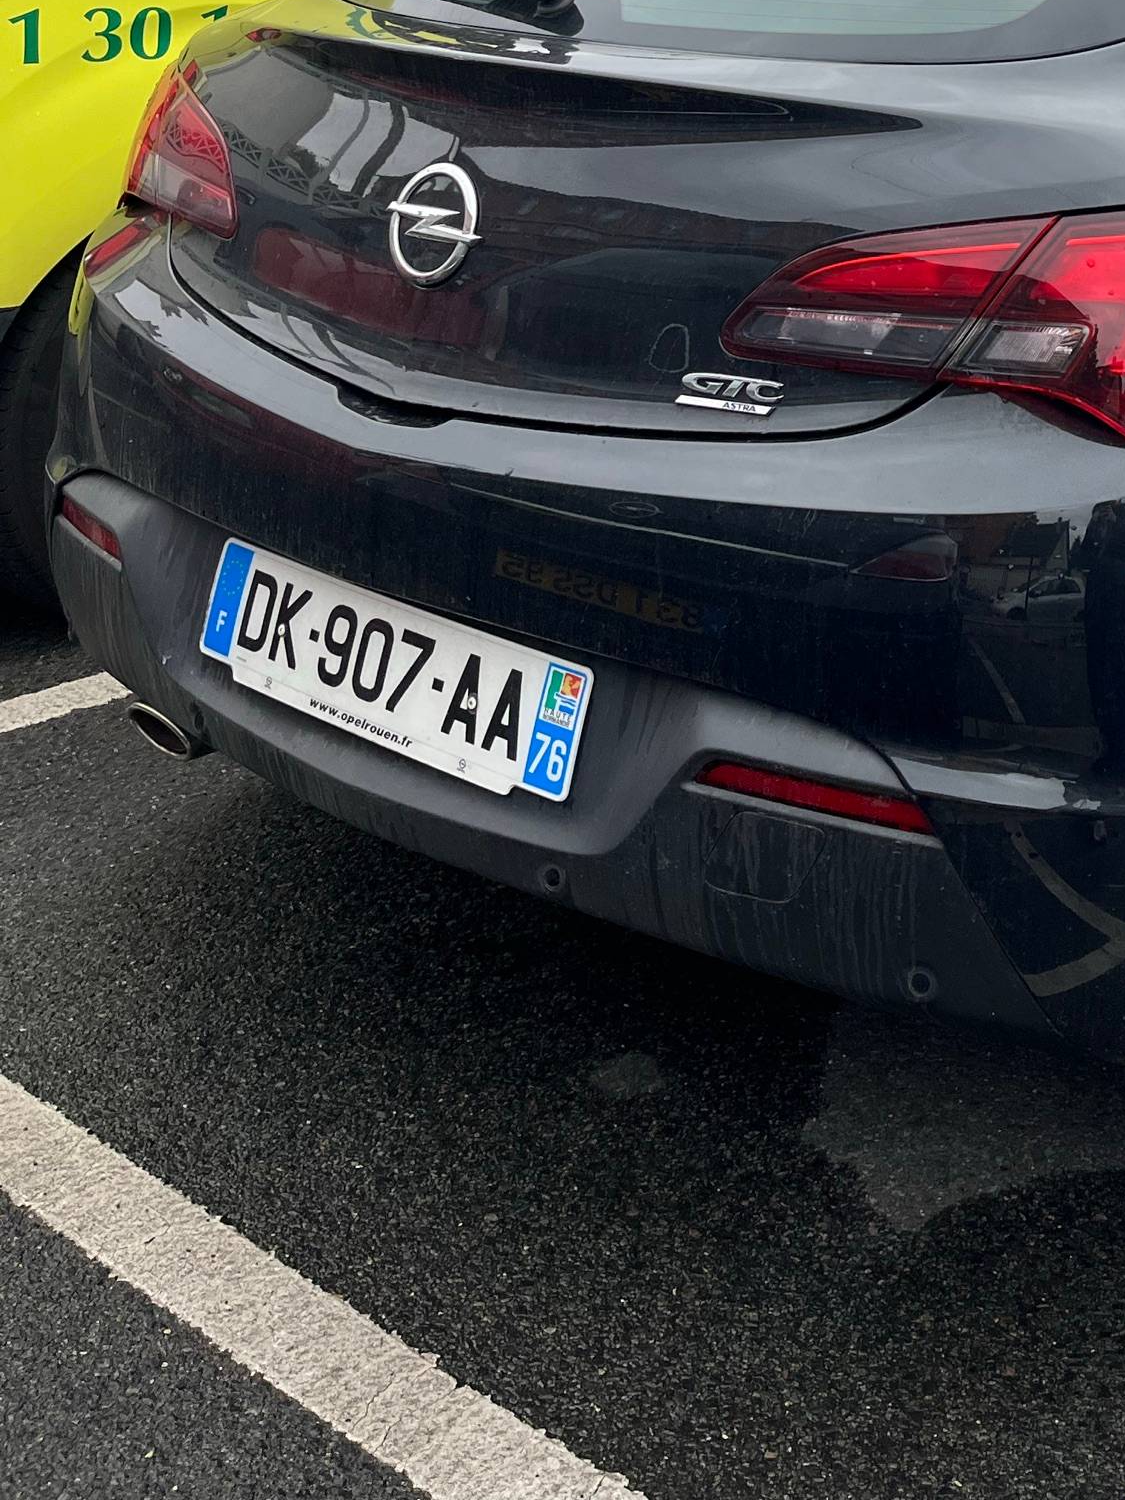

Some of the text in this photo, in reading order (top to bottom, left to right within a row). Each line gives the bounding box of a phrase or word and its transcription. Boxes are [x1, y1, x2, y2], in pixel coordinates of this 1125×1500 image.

[80, 6, 173, 62] 30
[681, 371, 785, 403] GTC
[722, 401, 757, 413] ASTRA
[215, 609, 228, 632] F
[236, 569, 525, 762] DK-907-AA
[309, 698, 413, 749] www.opelrouen.fr
[528, 731, 567, 783] 76
